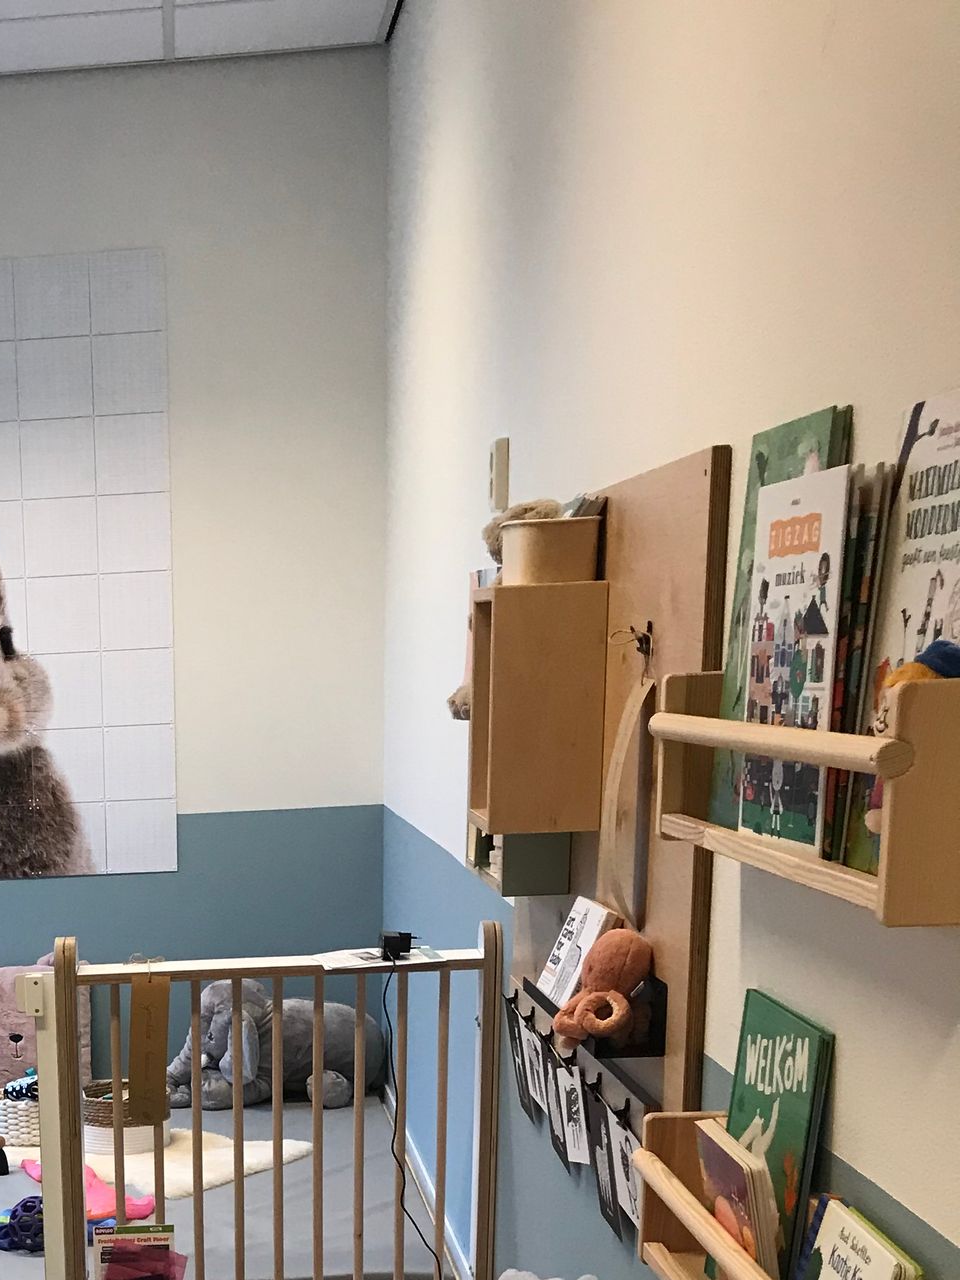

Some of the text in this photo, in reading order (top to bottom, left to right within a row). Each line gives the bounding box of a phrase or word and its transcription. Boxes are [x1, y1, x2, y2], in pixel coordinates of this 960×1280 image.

[771, 521, 819, 550] ZIGZAG
[775, 561, 805, 587] muziek
[745, 1033, 809, 1095] WELKOM
